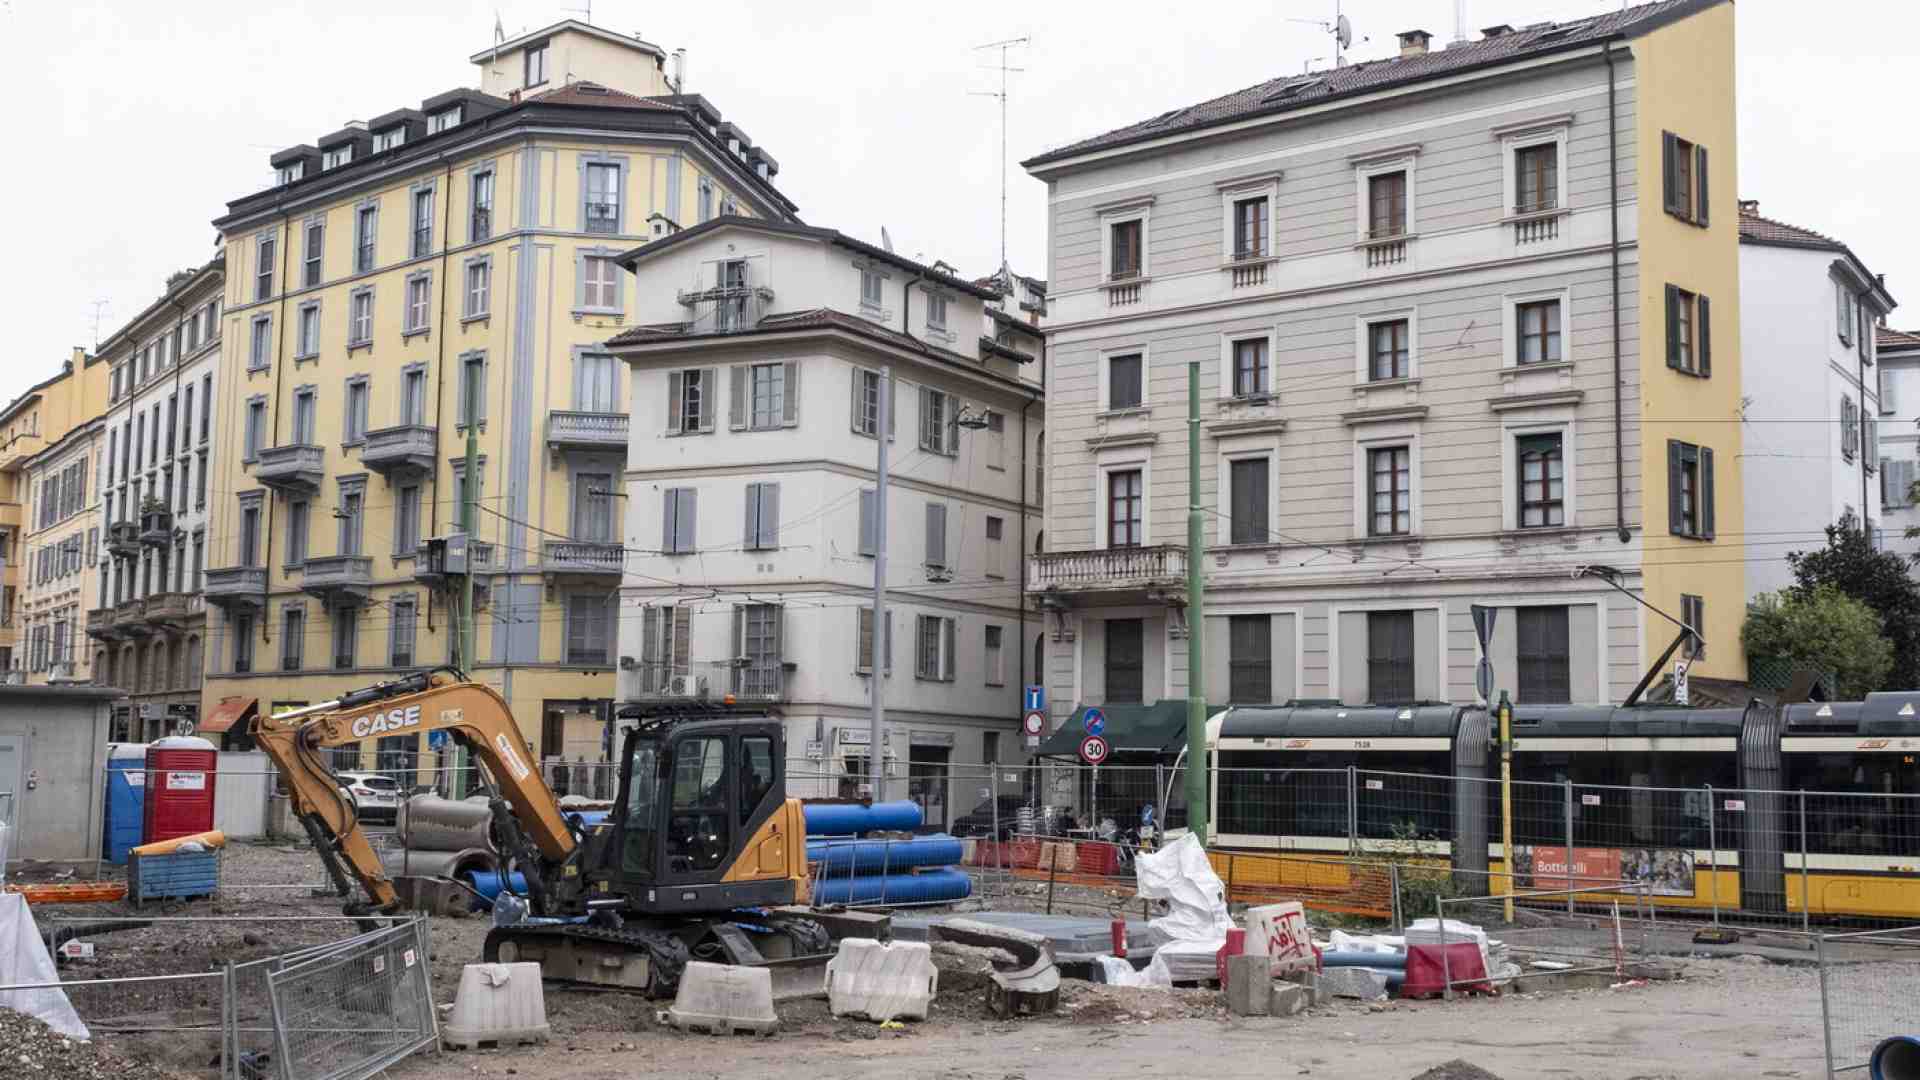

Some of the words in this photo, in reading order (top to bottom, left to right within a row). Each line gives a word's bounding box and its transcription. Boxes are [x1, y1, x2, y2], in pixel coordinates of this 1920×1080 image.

[352, 704, 421, 737] CASE
[1087, 743, 1102, 756] 30
[1537, 861, 1587, 873] Botticelli
